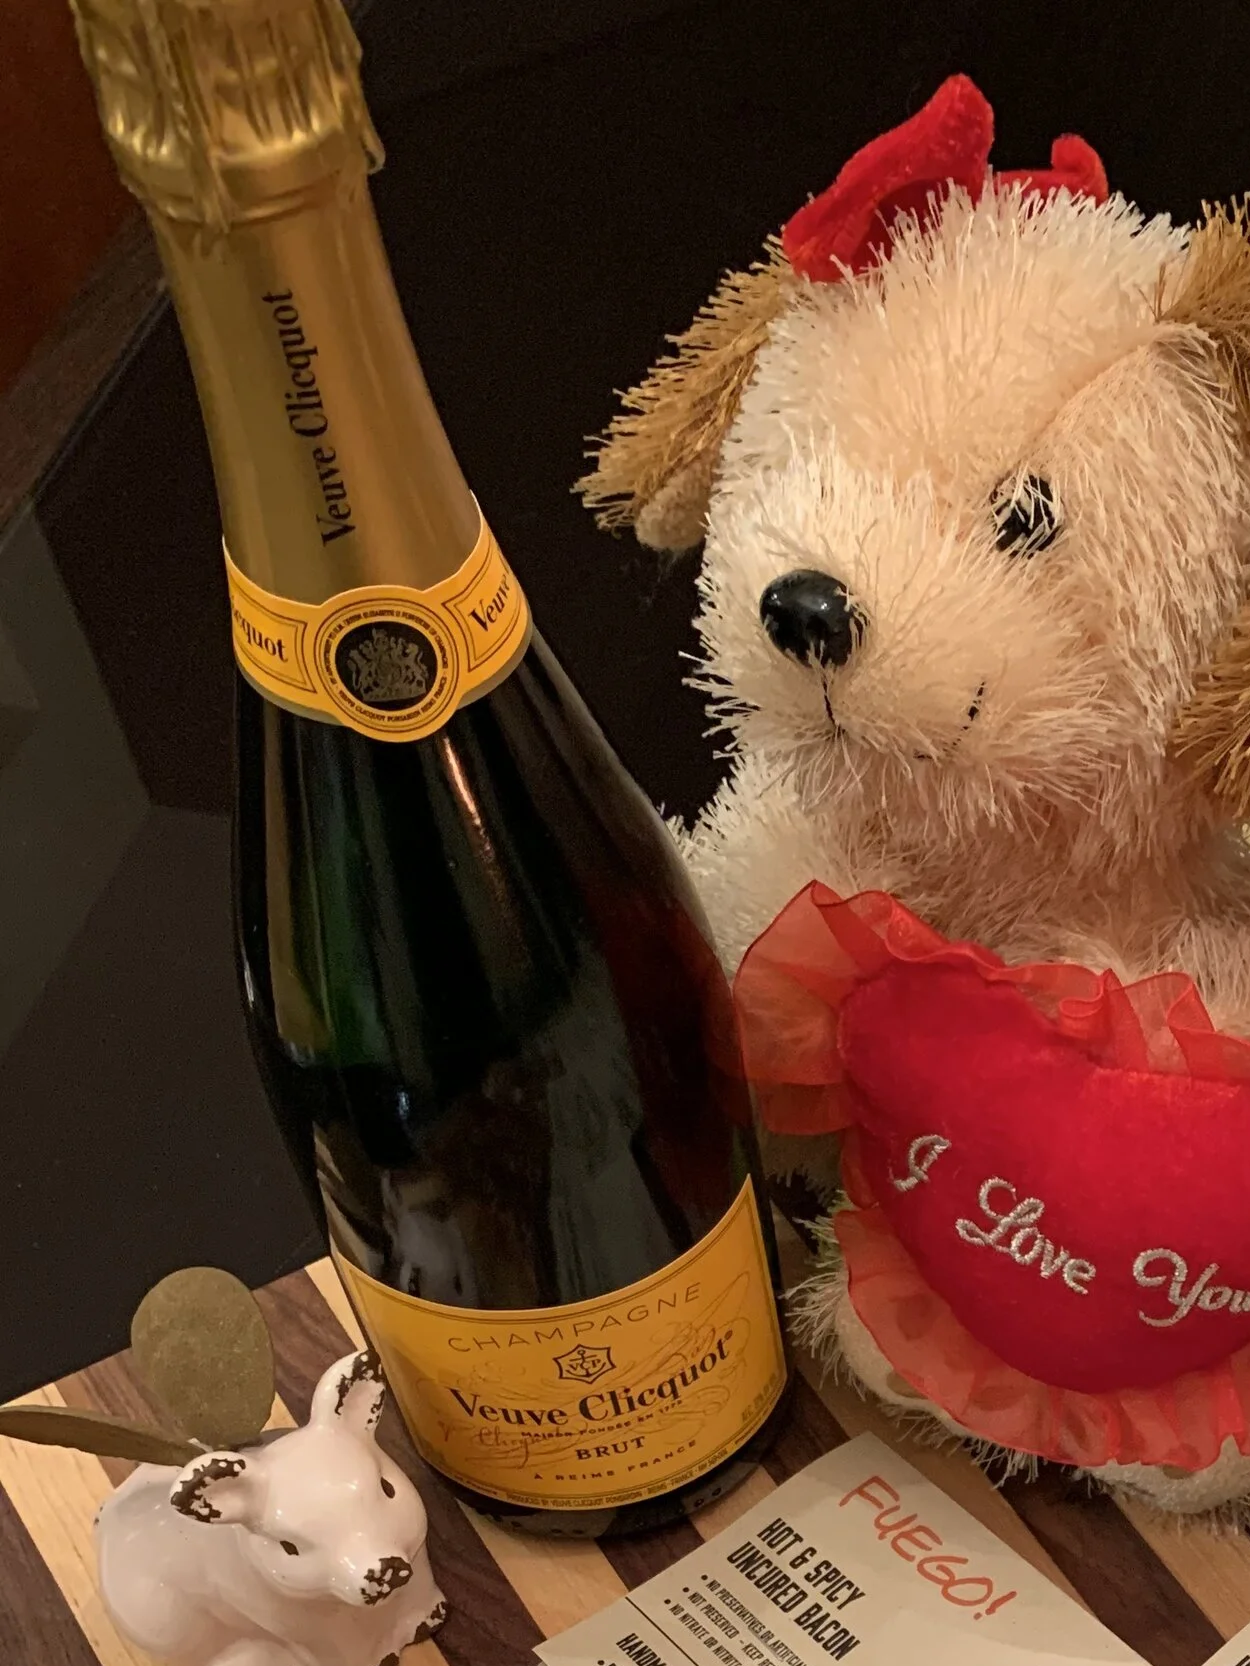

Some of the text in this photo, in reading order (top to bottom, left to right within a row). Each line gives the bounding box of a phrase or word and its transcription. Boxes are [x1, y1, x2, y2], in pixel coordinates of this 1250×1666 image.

[262, 288, 356, 547] Veuve Clicquot
[887, 1133, 952, 1192] I
[955, 1175, 1097, 1295] Love
[447, 1282, 703, 1353] CHAMPAGNE
[449, 1387, 568, 1427] Veuve
[578, 1338, 730, 1422] Clicquot
[555, 1469, 615, 1481] REIMS
[627, 1440, 697, 1472] FRANCE
[575, 1436, 647, 1461] BRUT
[756, 1517, 865, 1608] HOT & SPICY
[837, 1474, 1018, 1622] FUEGO!
[668, 1603, 684, 1615] NO
[678, 1612, 710, 1640] NITRATE
[702, 1636, 718, 1648] OR
[687, 1591, 707, 1606] NOT
[699, 1603, 740, 1639] PRESERVED
[740, 1642, 764, 1660] KEEP
[705, 1579, 721, 1592] NO
[714, 1587, 766, 1634] PRESERVATIVES
[759, 1629, 774, 1643] OR
[726, 1543, 860, 1660] UNCURED BACON
